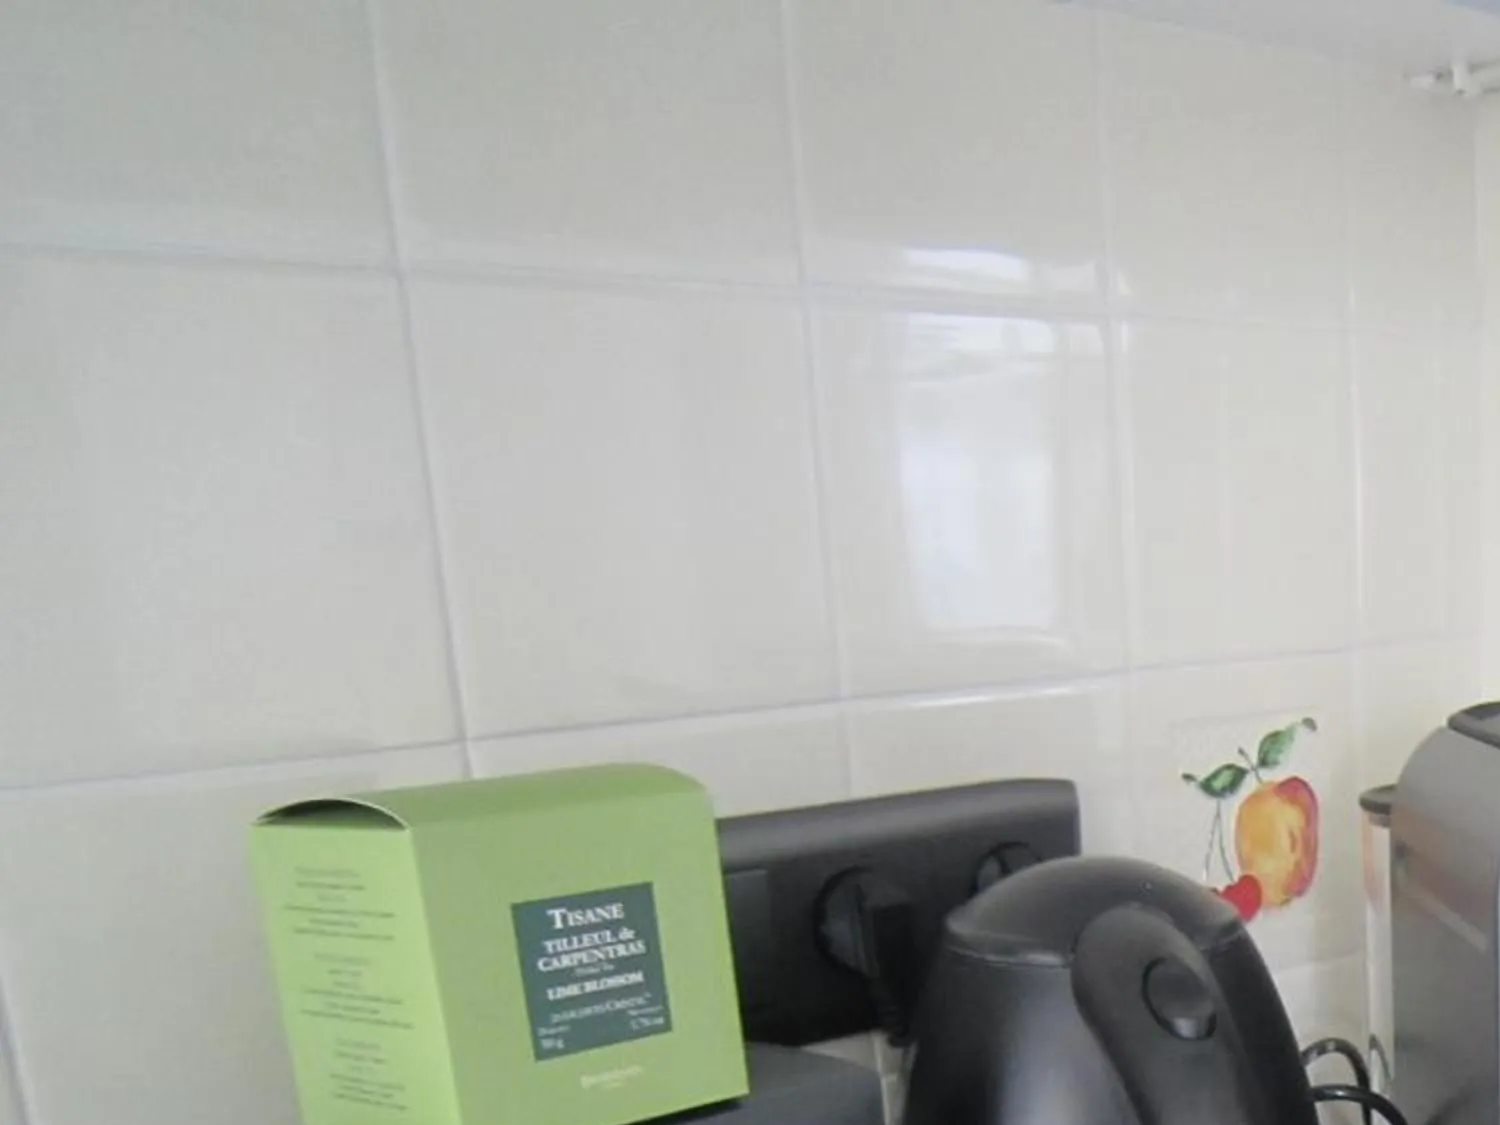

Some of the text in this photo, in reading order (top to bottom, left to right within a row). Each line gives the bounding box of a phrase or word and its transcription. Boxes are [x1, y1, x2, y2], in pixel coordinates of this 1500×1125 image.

[546, 903, 625, 929] TISANE
[544, 930, 616, 954] TILLEUL
[537, 940, 647, 971] CARPENTRAS
